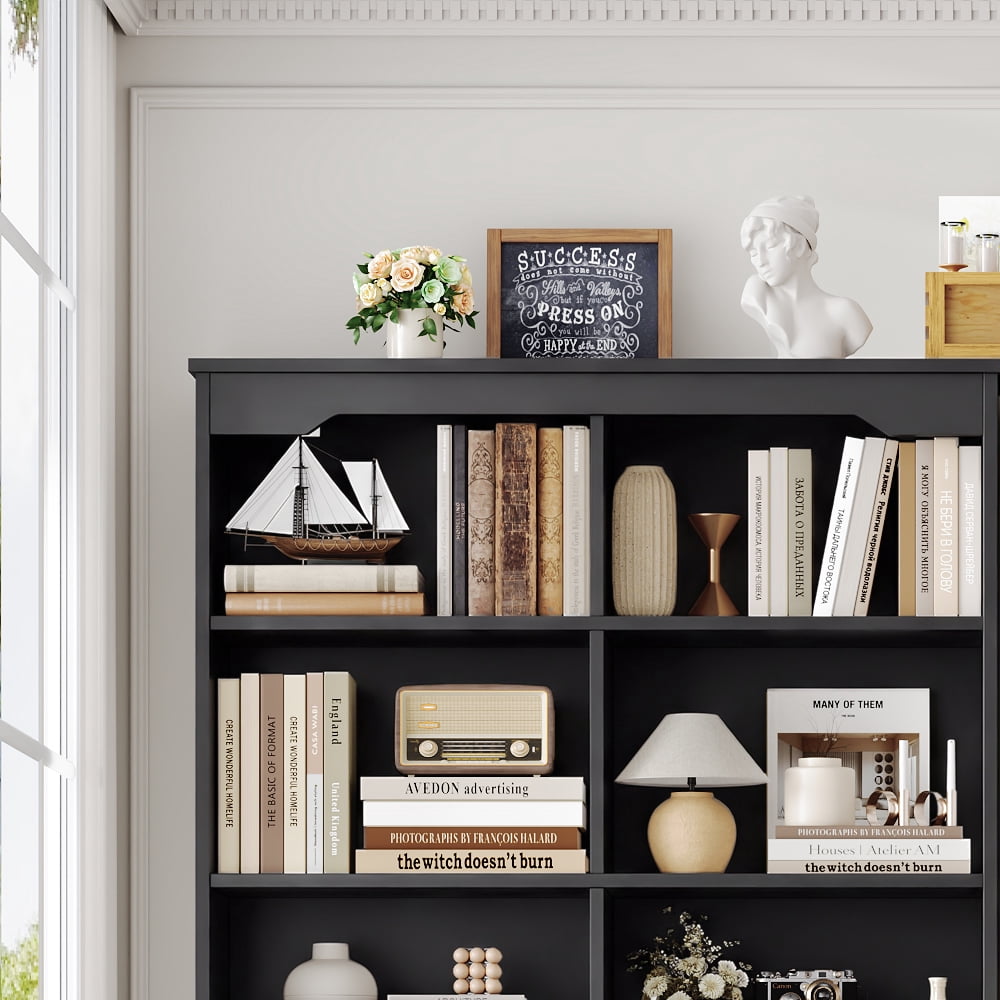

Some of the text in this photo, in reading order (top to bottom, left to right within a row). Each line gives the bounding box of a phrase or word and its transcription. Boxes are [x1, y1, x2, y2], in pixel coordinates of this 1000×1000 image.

[517, 246, 637, 273] SUCCESS
[520, 271, 540, 282] does
[547, 267, 562, 275] not
[596, 268, 634, 282] without
[536, 300, 625, 325] PRESS ON
[558, 327, 589, 337] you will
[544, 339, 618, 352] HAPPY END
[920, 473, 929, 497] МОГУ
[940, 490, 952, 504] НЕ
[920, 500, 929, 554] ОБЪЯСНИТЬ
[940, 507, 952, 537] БЕРИ
[794, 478, 804, 598] ЗАБОТА О ПРЕДАННЫХ
[860, 501, 886, 603] Религия черной водолазки
[920, 556, 929, 593] МНОГОЕ
[940, 549, 953, 593] ГОЛОВУ
[820, 572, 833, 604] ВОСТОКА
[813, 700, 884, 709] MANY OF THEM
[329, 698, 341, 745] England
[268, 716, 276, 828] THE BASIC OF FORMAT
[406, 782, 529, 797] AVEDON advertising
[329, 783, 340, 856] United Kingdom
[390, 832, 557, 846] PHOTOGRAPHS BY FRANÇOIS HALARD
[809, 844, 940, 855] Houses Atelier AM
[398, 853, 420, 869] the
[422, 853, 462, 869] witch
[520, 853, 553, 869] burn
